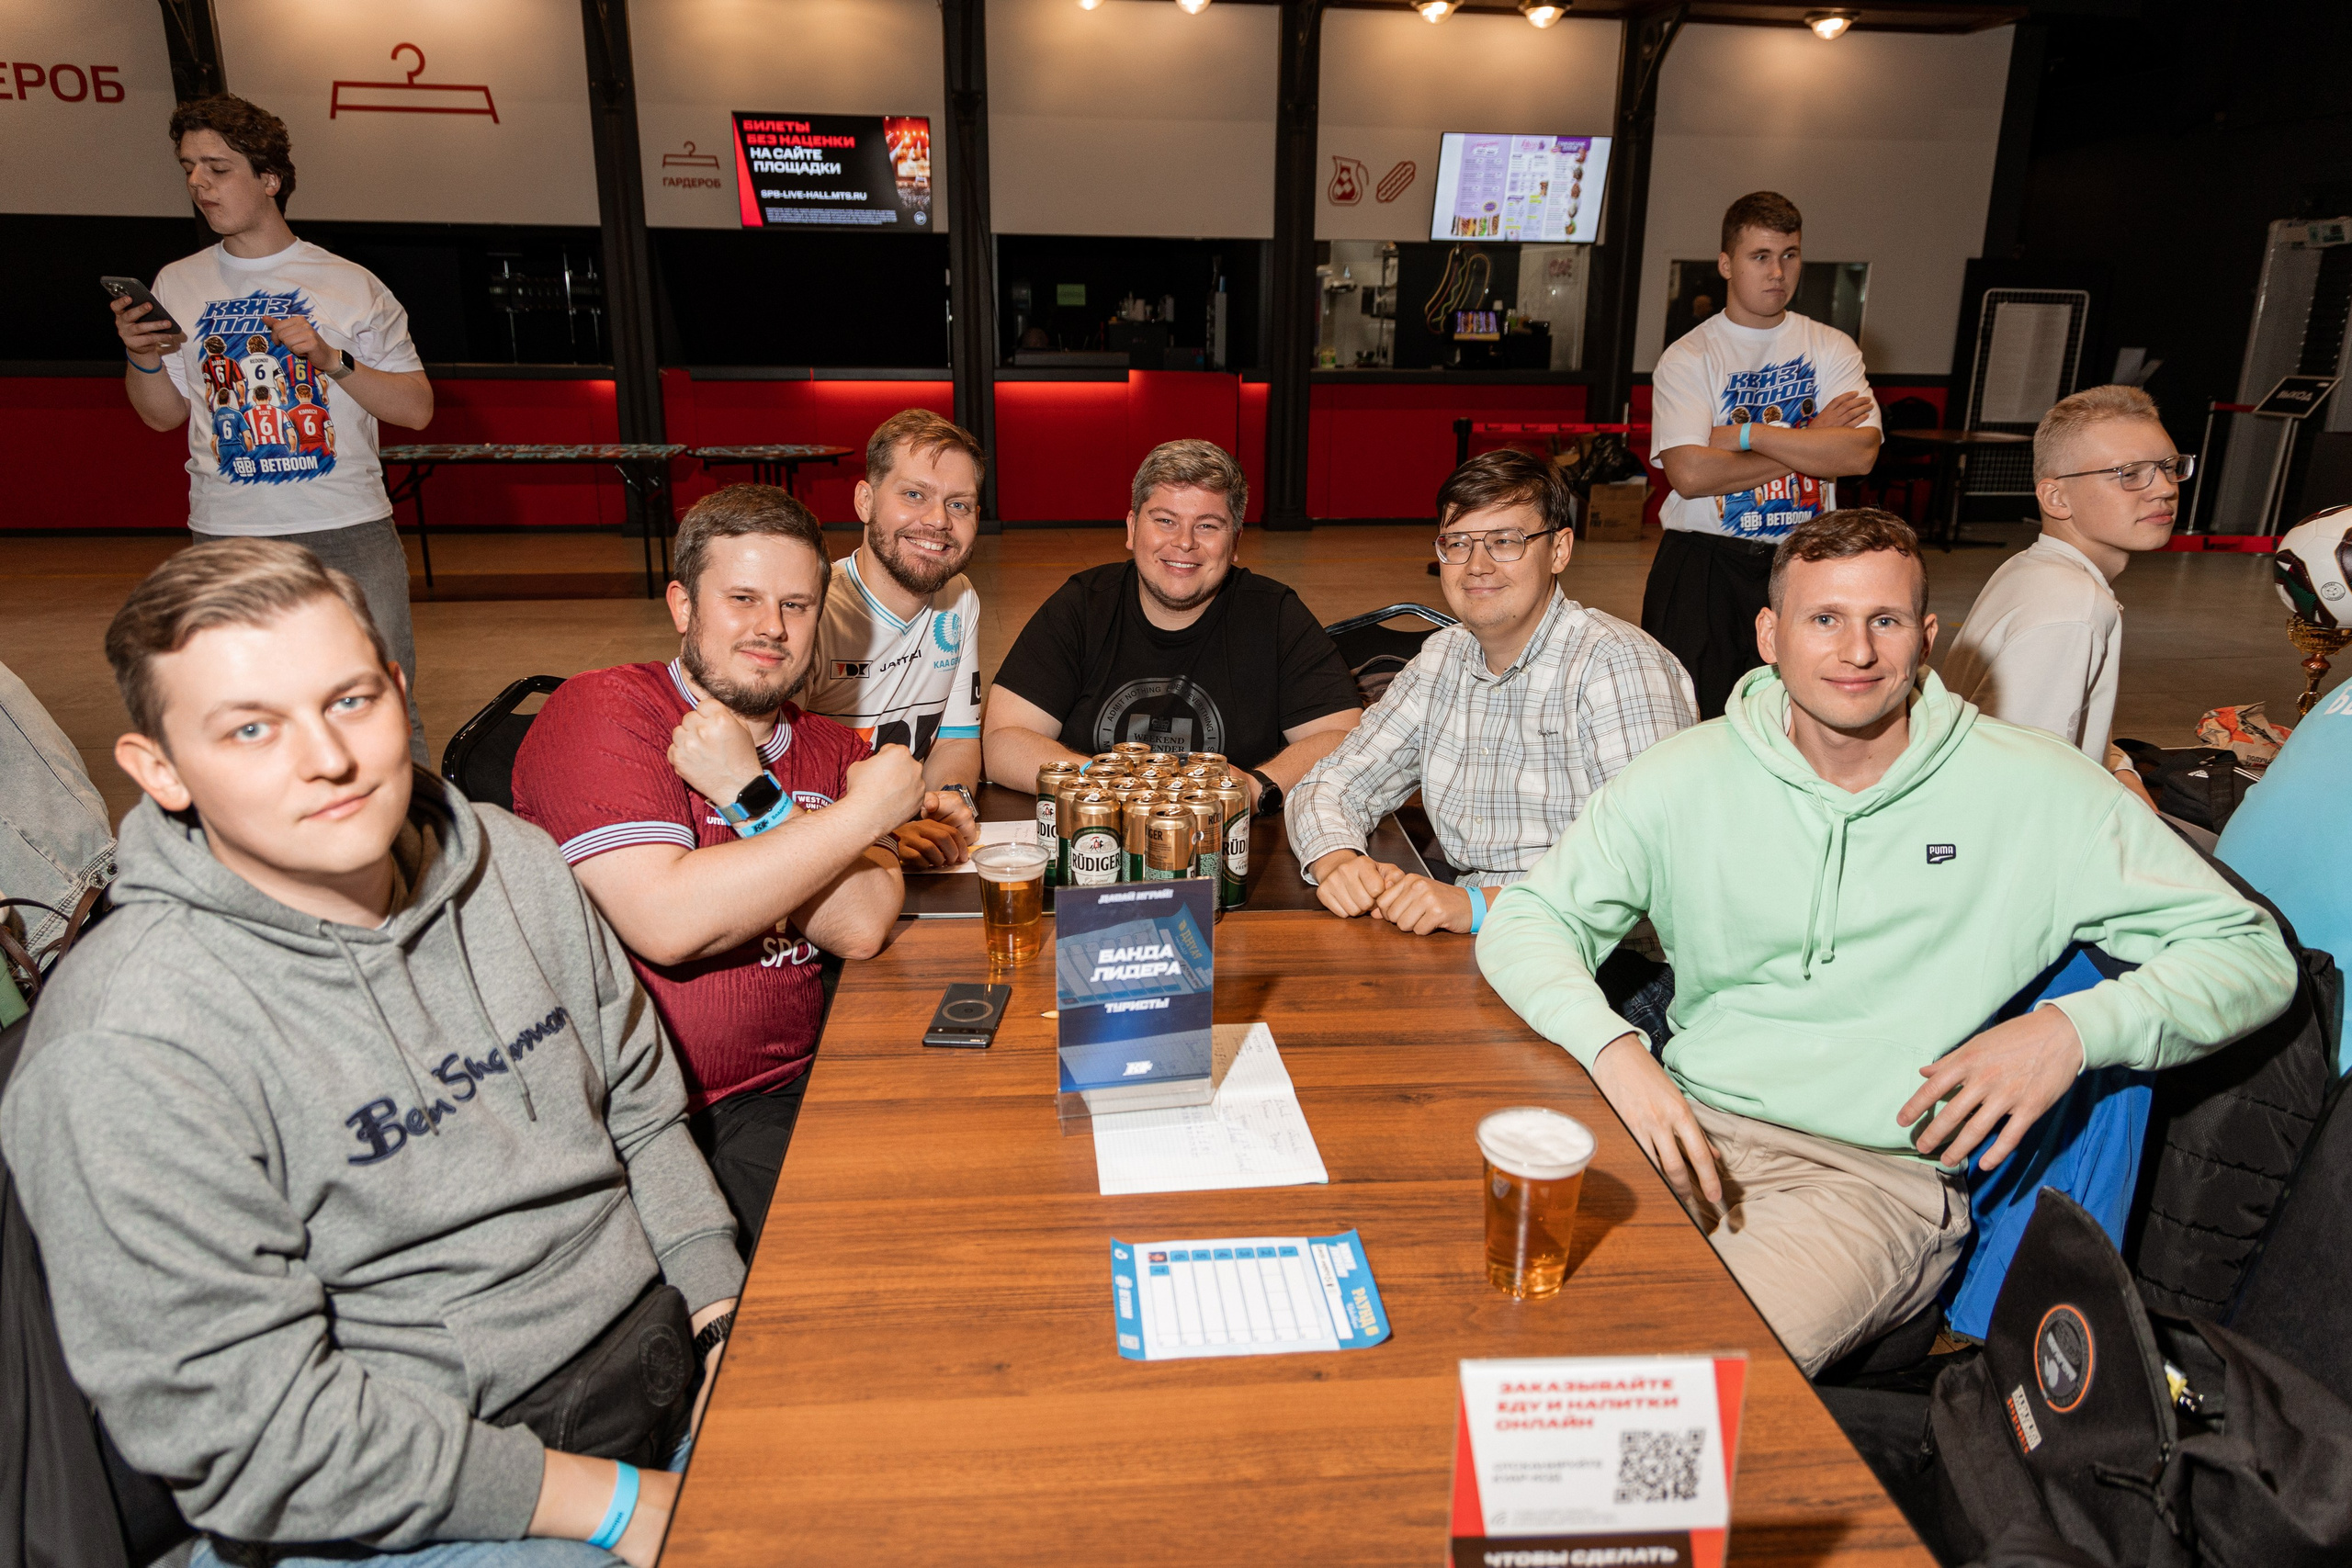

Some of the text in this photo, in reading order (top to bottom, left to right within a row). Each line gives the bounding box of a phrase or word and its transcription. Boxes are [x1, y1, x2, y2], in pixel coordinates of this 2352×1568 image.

[742, 119, 810, 134] БИЛЕТЫ
[746, 133, 855, 148] БЕЗ НАЦЕНКИ
[750, 145, 823, 161] НА САЙТЕ
[753, 160, 842, 176] ПЛОЩАДКИ
[662, 176, 721, 189] ГАРДЕРОБ
[203, 297, 292, 320] КВИЗ
[215, 366, 226, 384] 6
[254, 364, 266, 380] 6
[295, 364, 306, 381] 6
[1726, 364, 1799, 391] КВИЗ
[1736, 378, 1815, 406] ПЛЮС
[222, 420, 232, 440] 6
[259, 416, 273, 436] 6
[303, 415, 316, 435] 6
[259, 456, 318, 473] BETBOOM
[1766, 511, 1813, 526] BETBOOM
[933, 659, 950, 669] KAA
[1107, 699, 1125, 722] ADMIT
[1125, 686, 1161, 701] NOTHING
[1188, 693, 1215, 733] EVERYTHING
[1134, 732, 1185, 745] WEEKEND
[1150, 745, 1185, 753] ENDER
[797, 795, 820, 805] WEST
[1929, 846, 1953, 854] PUMA
[1072, 853, 1121, 872] RÜDIGER
[760, 937, 816, 967] SPO
[1098, 943, 1174, 964] БАНДА
[1090, 960, 1182, 982] ЛИДЕРА
[1104, 997, 1170, 1013] ТУРИСТЫ
[345, 1097, 457, 1166] Ben
[1351, 1287, 1376, 1328] РАУНД
[1499, 1377, 1675, 1394] ЗАКАЗЫВАЙТЕ
[1497, 1397, 1680, 1415] ЕДУ И НАПИТКИ
[1495, 1416, 1595, 1431] ОНЛАЙН
[1484, 1546, 1679, 1568] ЧТОБЫ СДЕЛАТЬ
